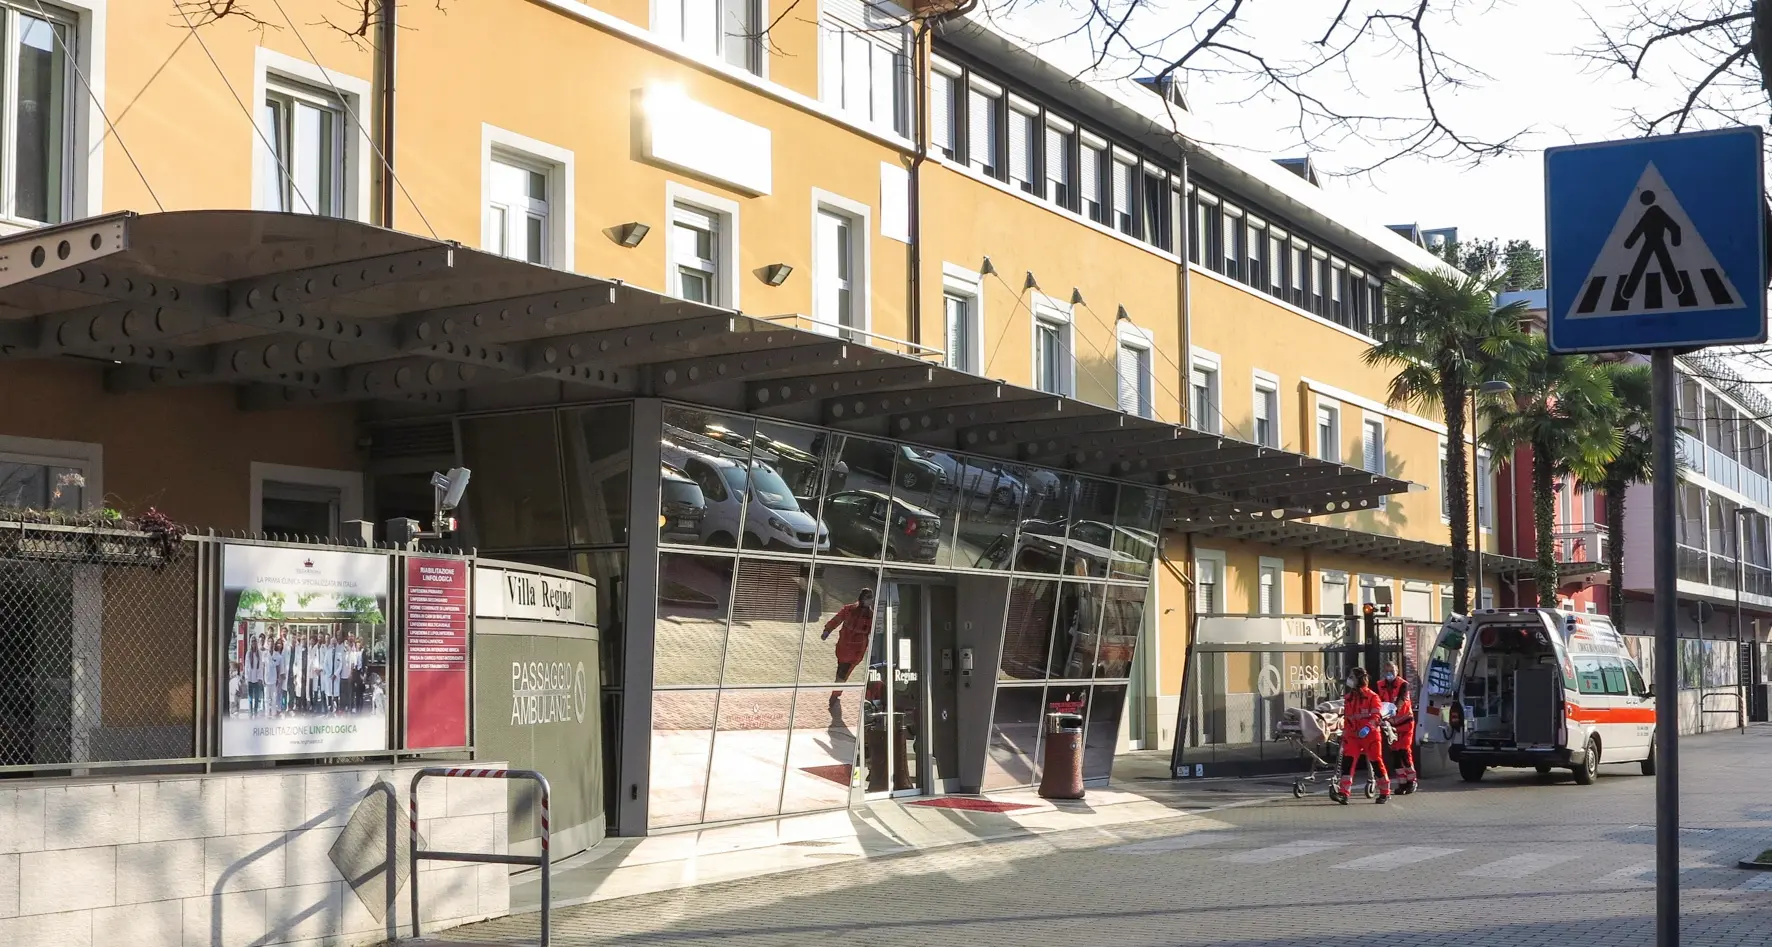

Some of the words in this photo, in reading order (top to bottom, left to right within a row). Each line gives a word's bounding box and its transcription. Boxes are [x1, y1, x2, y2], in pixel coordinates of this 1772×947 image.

[507, 575, 536, 606] Villa
[541, 580, 572, 616] Regina
[1286, 620, 1312, 637] Villa
[512, 661, 572, 691] PASSAGGIO
[894, 669, 918, 684] Regina
[510, 694, 572, 725] AMBULANZE
[253, 726, 308, 736] RIABILITAZIONE
[309, 724, 358, 735] LINFOLOGICA
